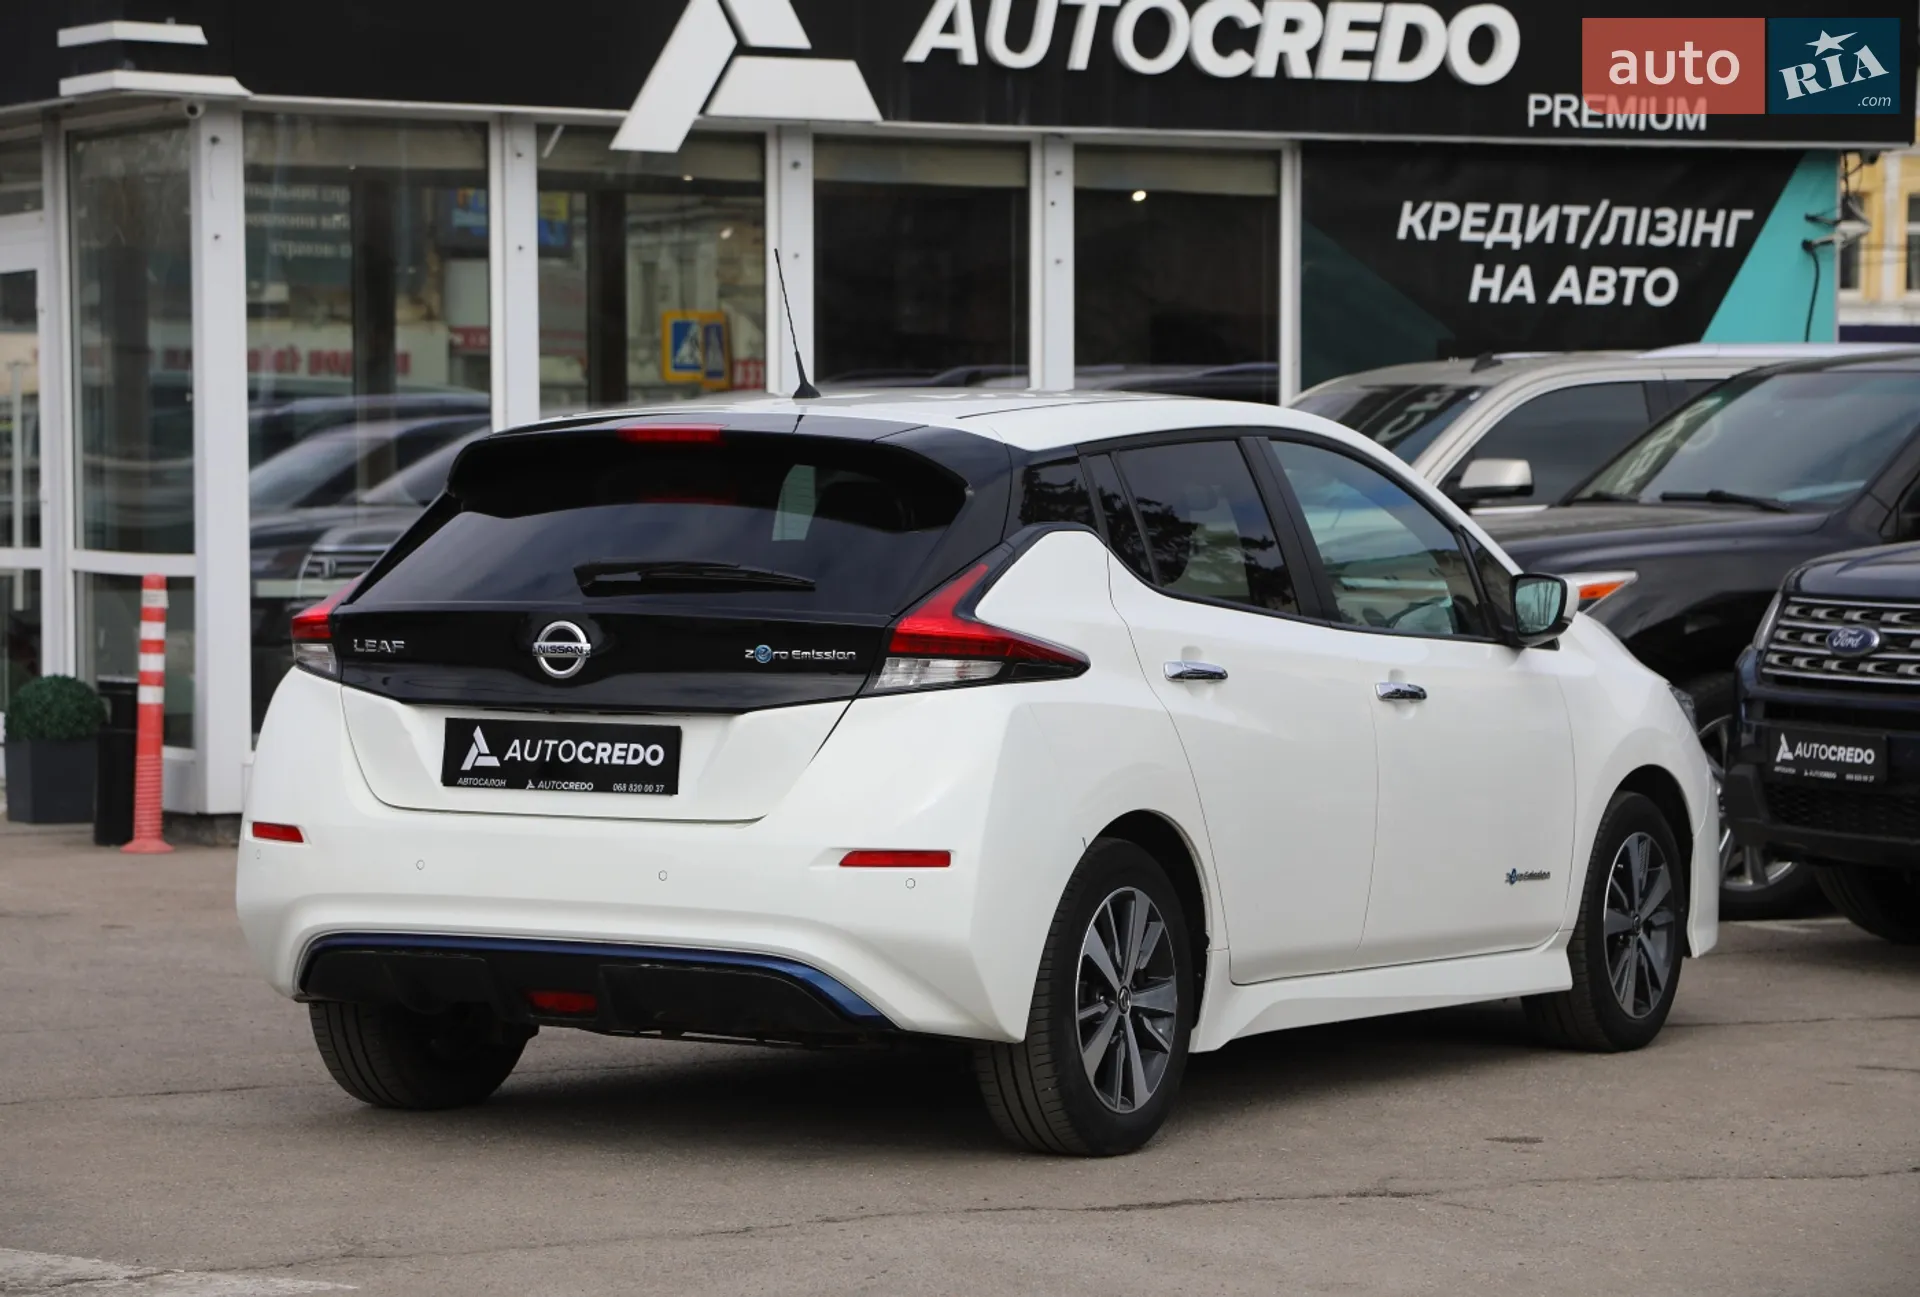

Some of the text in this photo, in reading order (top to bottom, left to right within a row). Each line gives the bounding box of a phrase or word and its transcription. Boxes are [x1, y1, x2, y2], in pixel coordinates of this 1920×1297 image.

[903, 0, 1521, 86] AUTOCREDO
[1528, 93, 1706, 131] PREMIUM
[1396, 199, 1754, 249] КРЕДИТ/ЛІЗІНГ
[1468, 264, 1679, 307] НА АВТО
[353, 638, 405, 653] LEAF
[1833, 628, 1865, 648] Ford
[536, 644, 586, 655] NISSAN
[791, 648, 856, 660] Emission
[503, 738, 665, 767] AUTOCREDO
[1794, 741, 1875, 765] AUTOCREDO
[457, 777, 507, 788] АВТОСАЛОН
[537, 779, 594, 791] AUTOCREDO
[655, 784, 666, 793] 37
